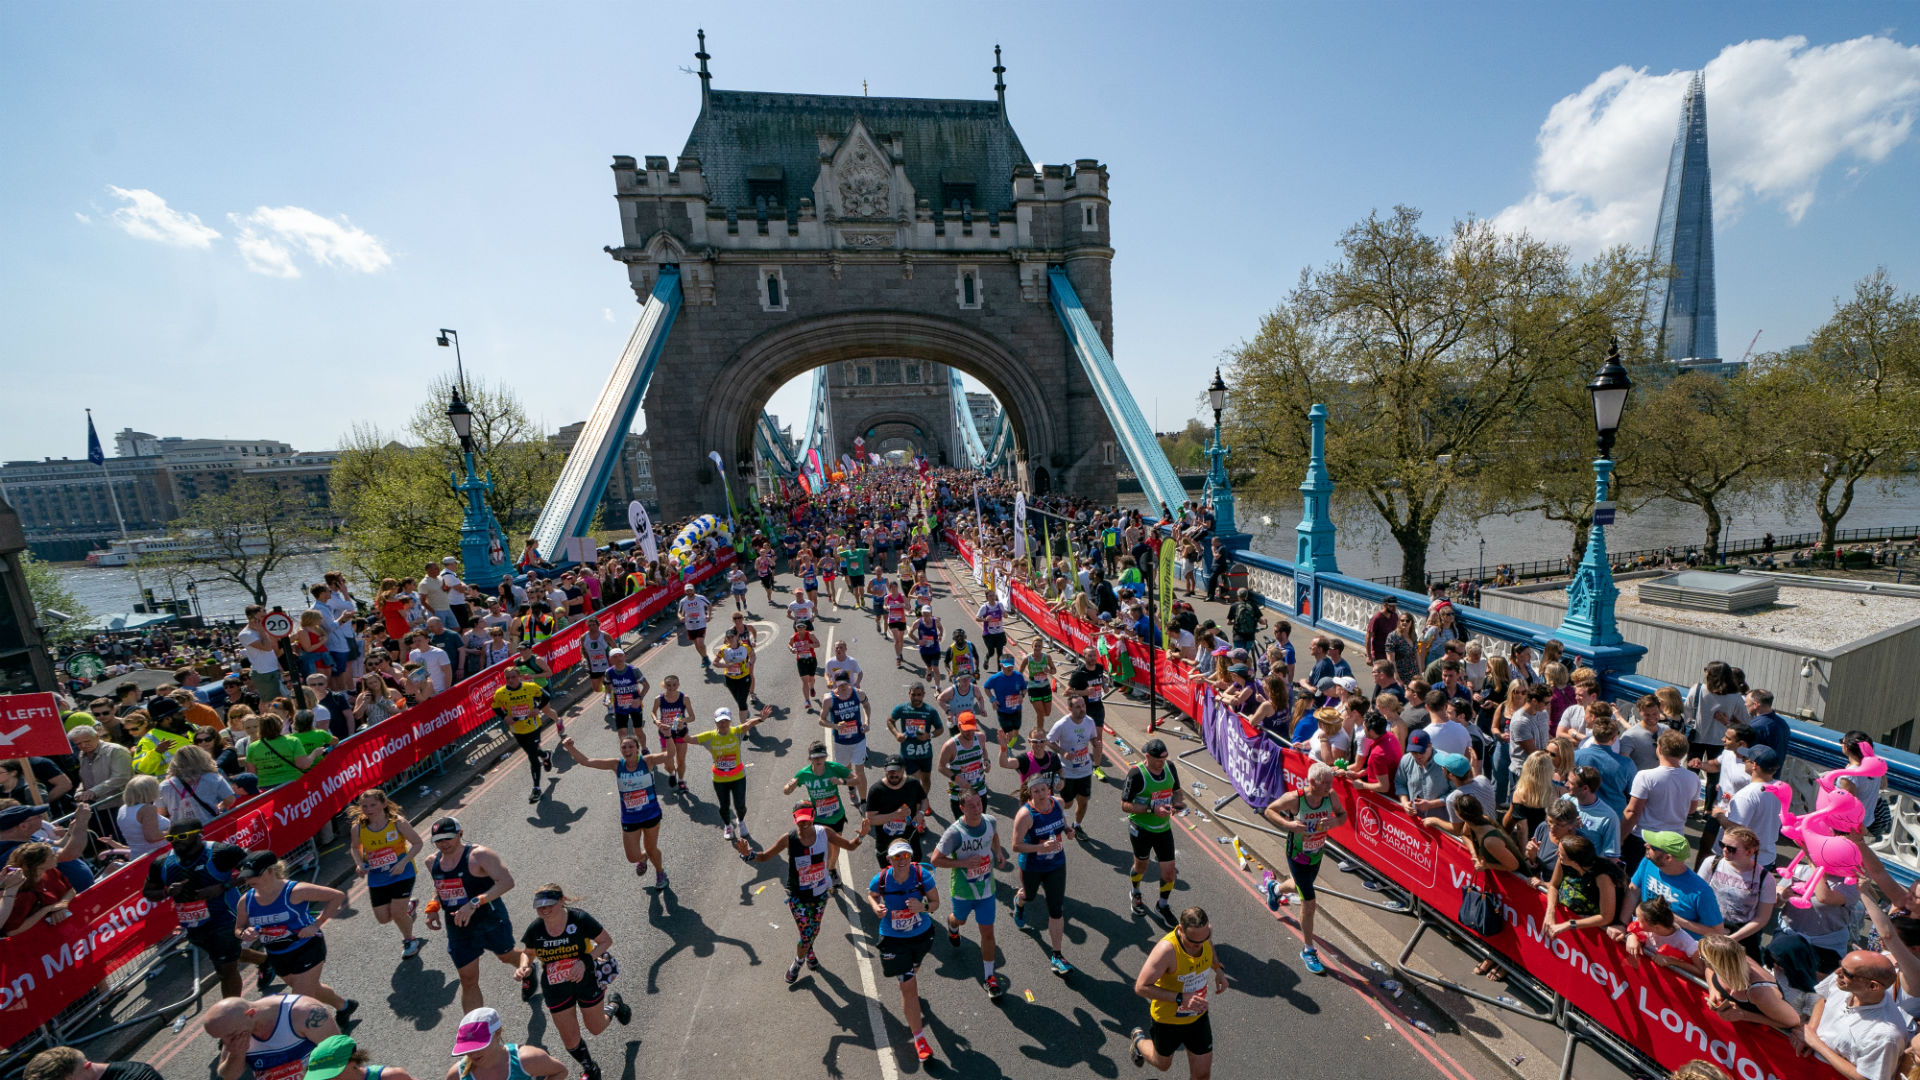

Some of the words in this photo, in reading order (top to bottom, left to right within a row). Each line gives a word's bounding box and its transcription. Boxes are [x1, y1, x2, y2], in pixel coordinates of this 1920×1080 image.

[266, 619, 289, 631] 20
[838, 700, 855, 709] BEN
[6, 707, 53, 721] LEFT!
[274, 789, 323, 826] Virgin
[322, 764, 363, 797] Money
[363, 732, 411, 769] London
[411, 704, 466, 742] Marathon
[1304, 810, 1329, 820] JOHN
[1360, 831, 1379, 847] money
[1382, 820, 1421, 850] LONDON
[961, 838, 984, 852] JACK
[1381, 832, 1432, 869] MARATHON
[253, 914, 280, 925] ELLE
[41, 896, 170, 979] Maratho
[543, 938, 569, 948] STEPH
[536, 944, 579, 957] Chorlton
[1526, 913, 1629, 1000] Money
[1639, 985, 1778, 1080] Londo
